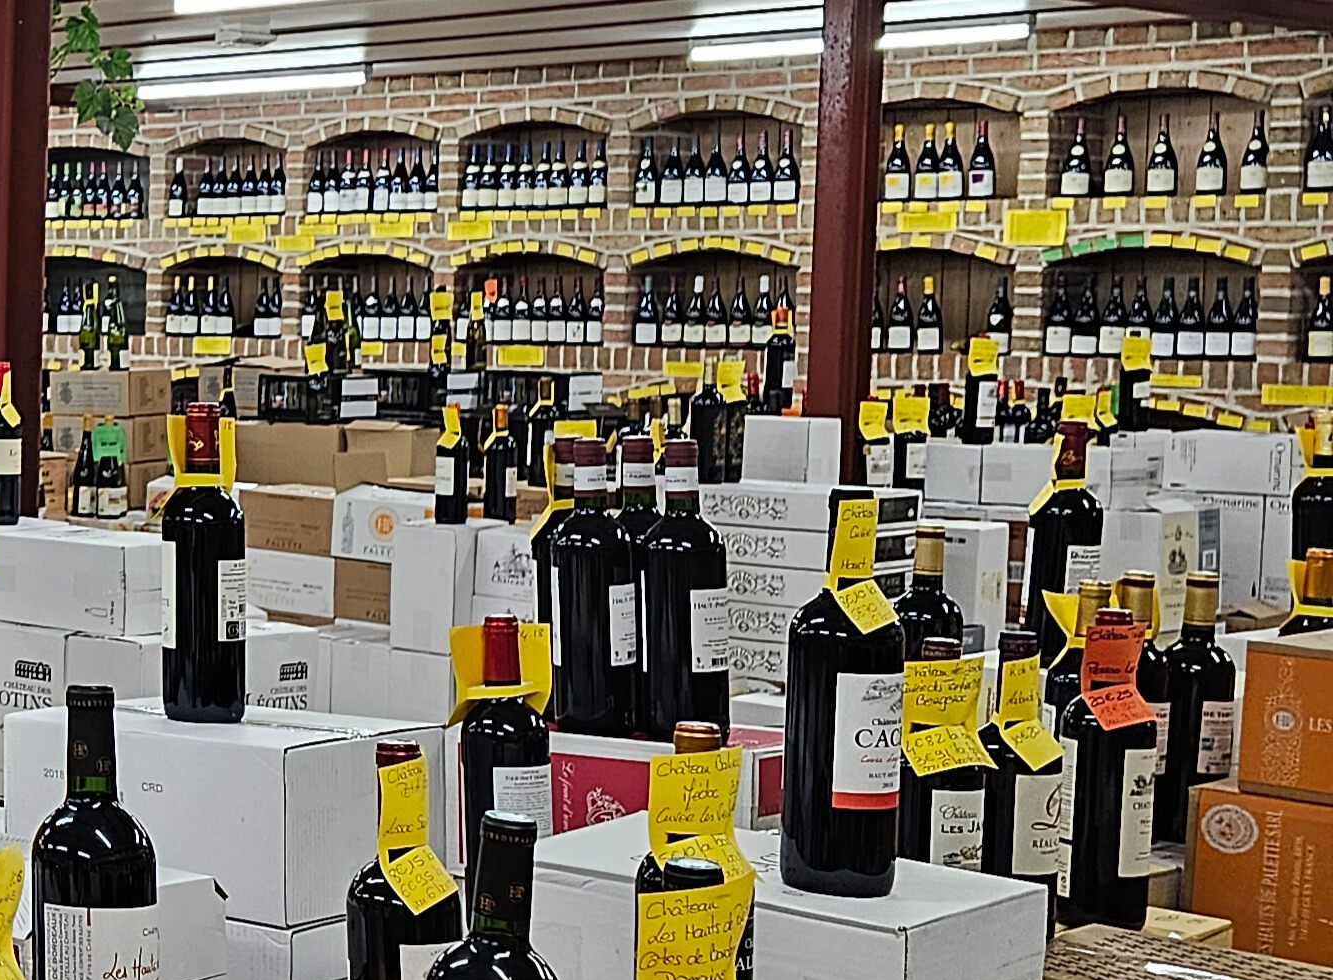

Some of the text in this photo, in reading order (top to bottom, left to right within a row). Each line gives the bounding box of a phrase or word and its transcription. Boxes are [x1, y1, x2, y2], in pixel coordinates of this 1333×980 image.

[43, 768, 64, 779] 2018
[142, 782, 163, 793] CRD
[939, 804, 978, 820] Château
[941, 823, 966, 834] LES
[646, 900, 719, 920] Château
